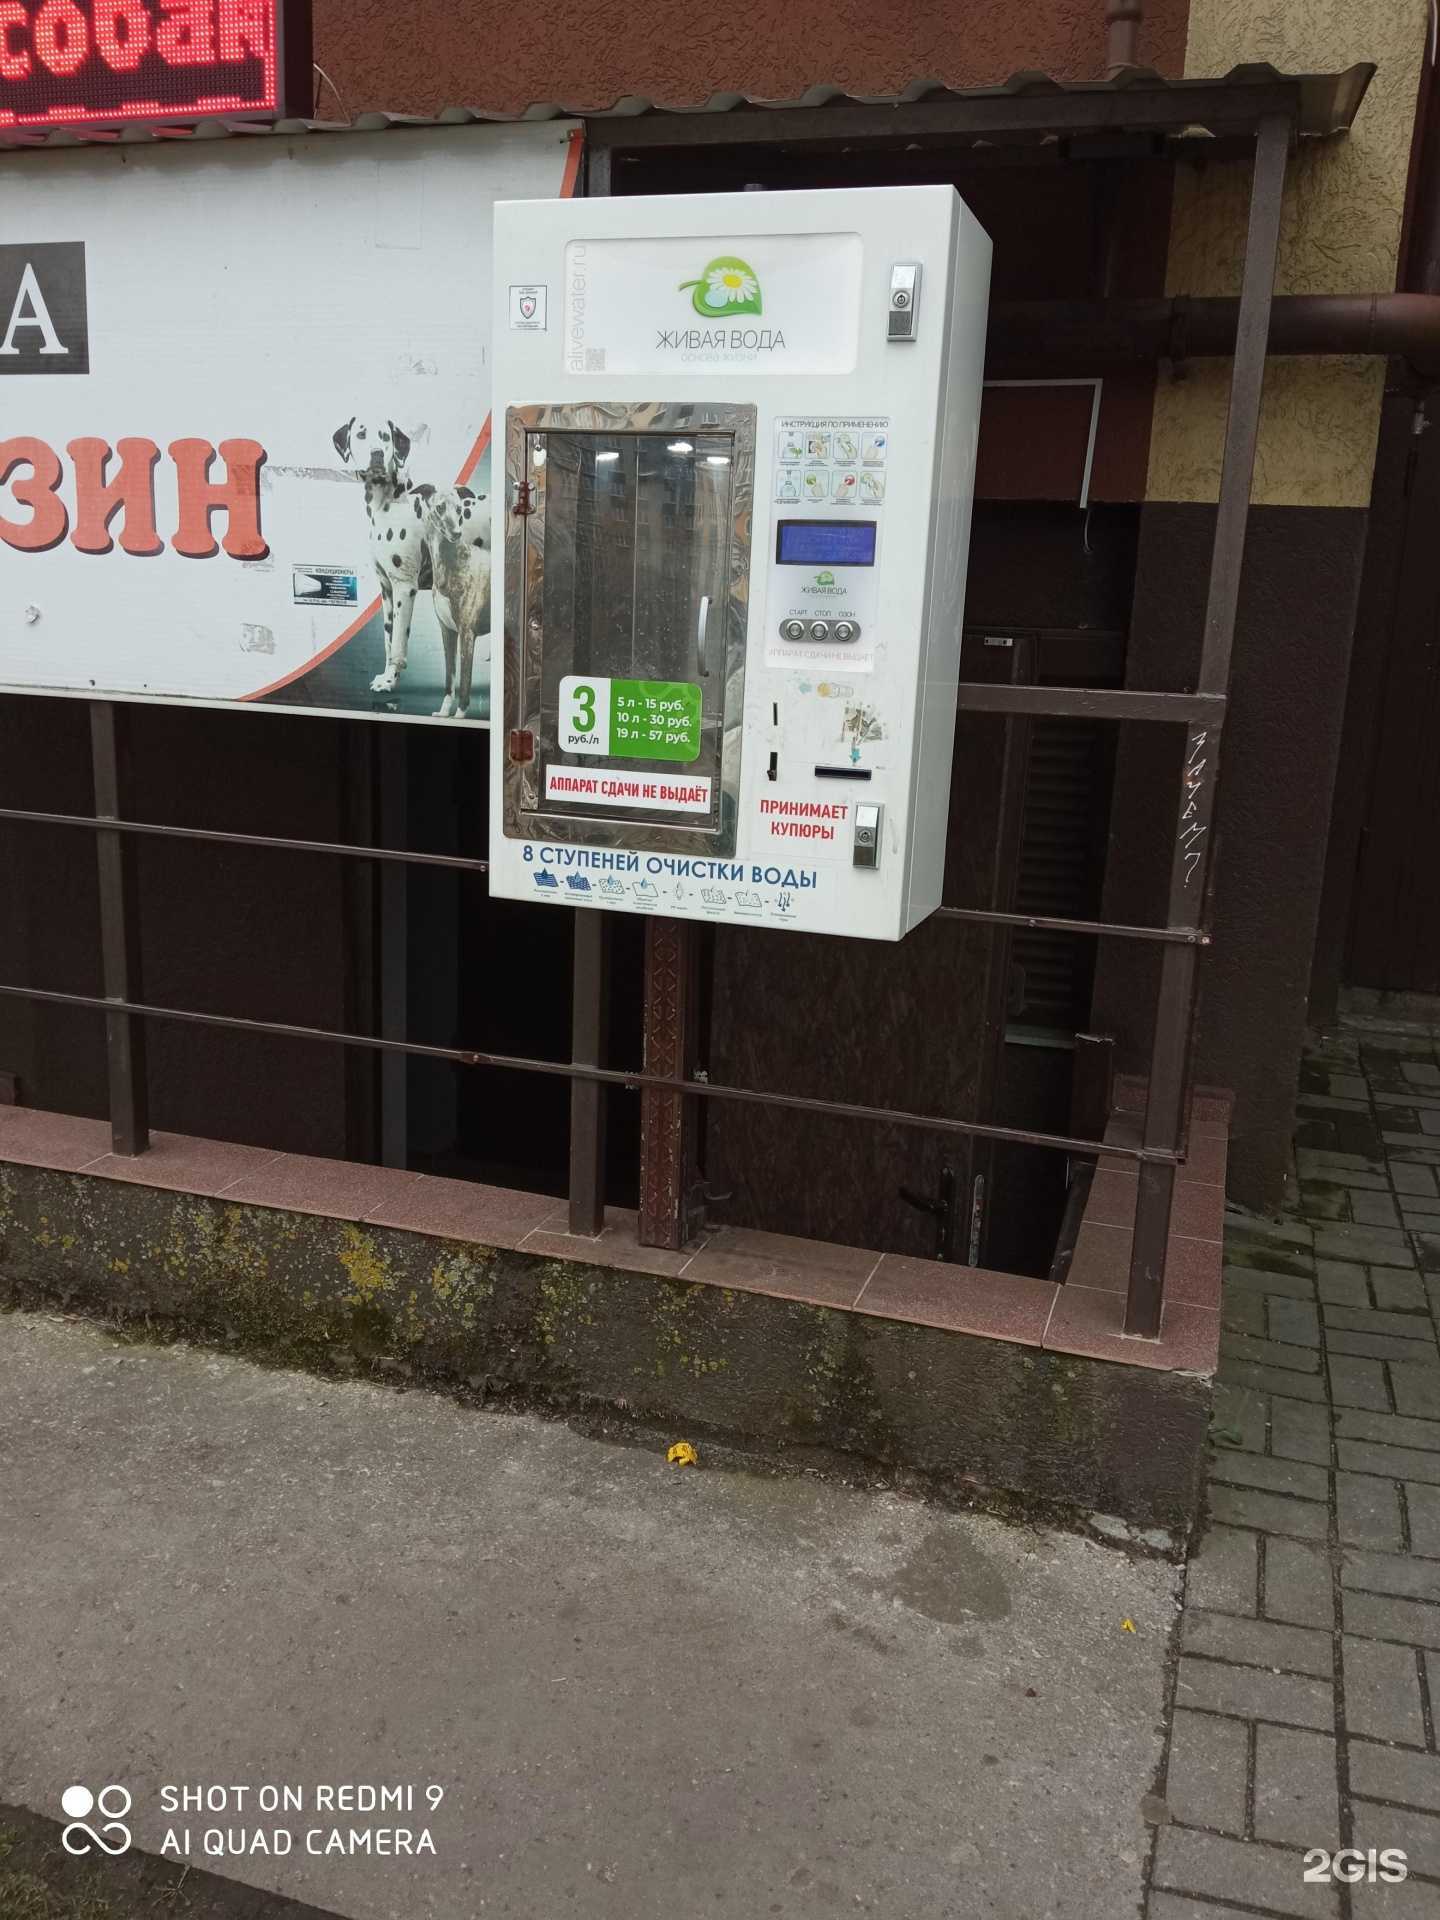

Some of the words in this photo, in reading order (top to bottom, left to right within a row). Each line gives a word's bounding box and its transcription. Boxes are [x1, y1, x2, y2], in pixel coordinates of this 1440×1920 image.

[568, 243, 587, 372] alivewater.ru
[656, 329, 726, 349] ЖИВАЯ
[730, 329, 786, 351] ВОДА
[781, 420, 827, 429] ИНСТРУКЦИЯ
[828, 420, 838, 428] ПО
[839, 420, 889, 428] ПРИМЕНЕНИЮ
[801, 586, 826, 594] ЖИВАЯ
[827, 587, 847, 595] ВОДА
[814, 609, 831, 617] СТОП
[572, 685, 596, 732] 3
[617, 696, 625, 707] 5
[627, 699, 635, 708] л
[645, 698, 657, 709] 15
[659, 700, 685, 712] руб.
[617, 711, 629, 722] 10
[631, 715, 640, 723] л
[649, 714, 665, 725] 30
[667, 716, 692, 728] руб.
[568, 733, 600, 745] руб./л
[617, 728, 628, 738] 19
[630, 730, 639, 739] л
[649, 730, 663, 741] 57
[665, 732, 691, 744] руб.
[549, 776, 598, 794] АППАРАТ
[601, 780, 640, 799] СДАЧИ
[643, 784, 657, 799] НЕ
[660, 785, 708, 804] ВЫДАЁТ
[760, 799, 849, 820] ПРИНИМАЕТ
[771, 821, 835, 840] КУПЮРЫ
[522, 845, 534, 862] 8
[540, 846, 640, 873] СТУПЕНЕЙ
[646, 856, 744, 882] ОЧИСТКИ
[751, 866, 818, 889] ВОДЫ
